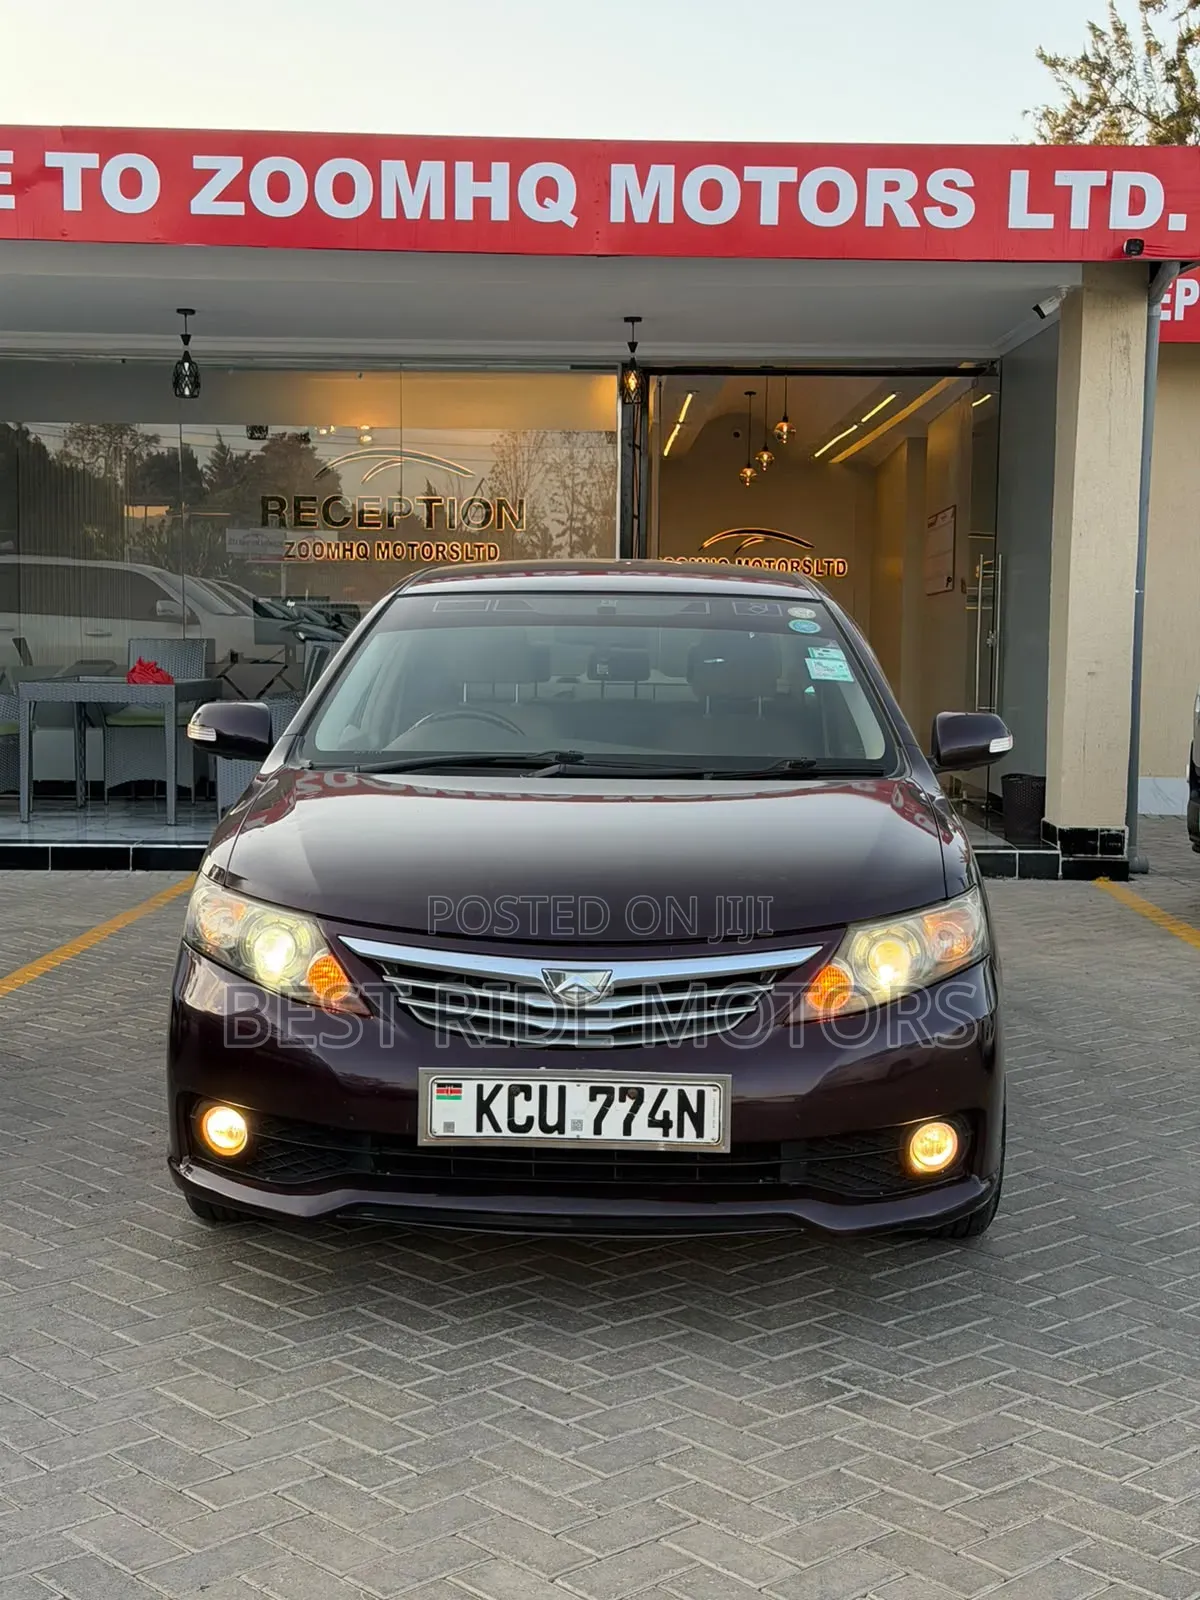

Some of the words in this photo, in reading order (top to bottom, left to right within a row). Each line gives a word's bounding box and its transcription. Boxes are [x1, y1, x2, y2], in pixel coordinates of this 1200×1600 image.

[45, 151, 161, 214] TO
[190, 155, 579, 228] ZOOMHQ
[609, 163, 976, 230] MOTORS
[1007, 169, 1187, 231] LTD.
[260, 494, 527, 531] RECEPTION
[284, 539, 370, 561] ZOOMHQ
[476, 1082, 567, 1136] KCU
[588, 1085, 706, 1139] 774N
